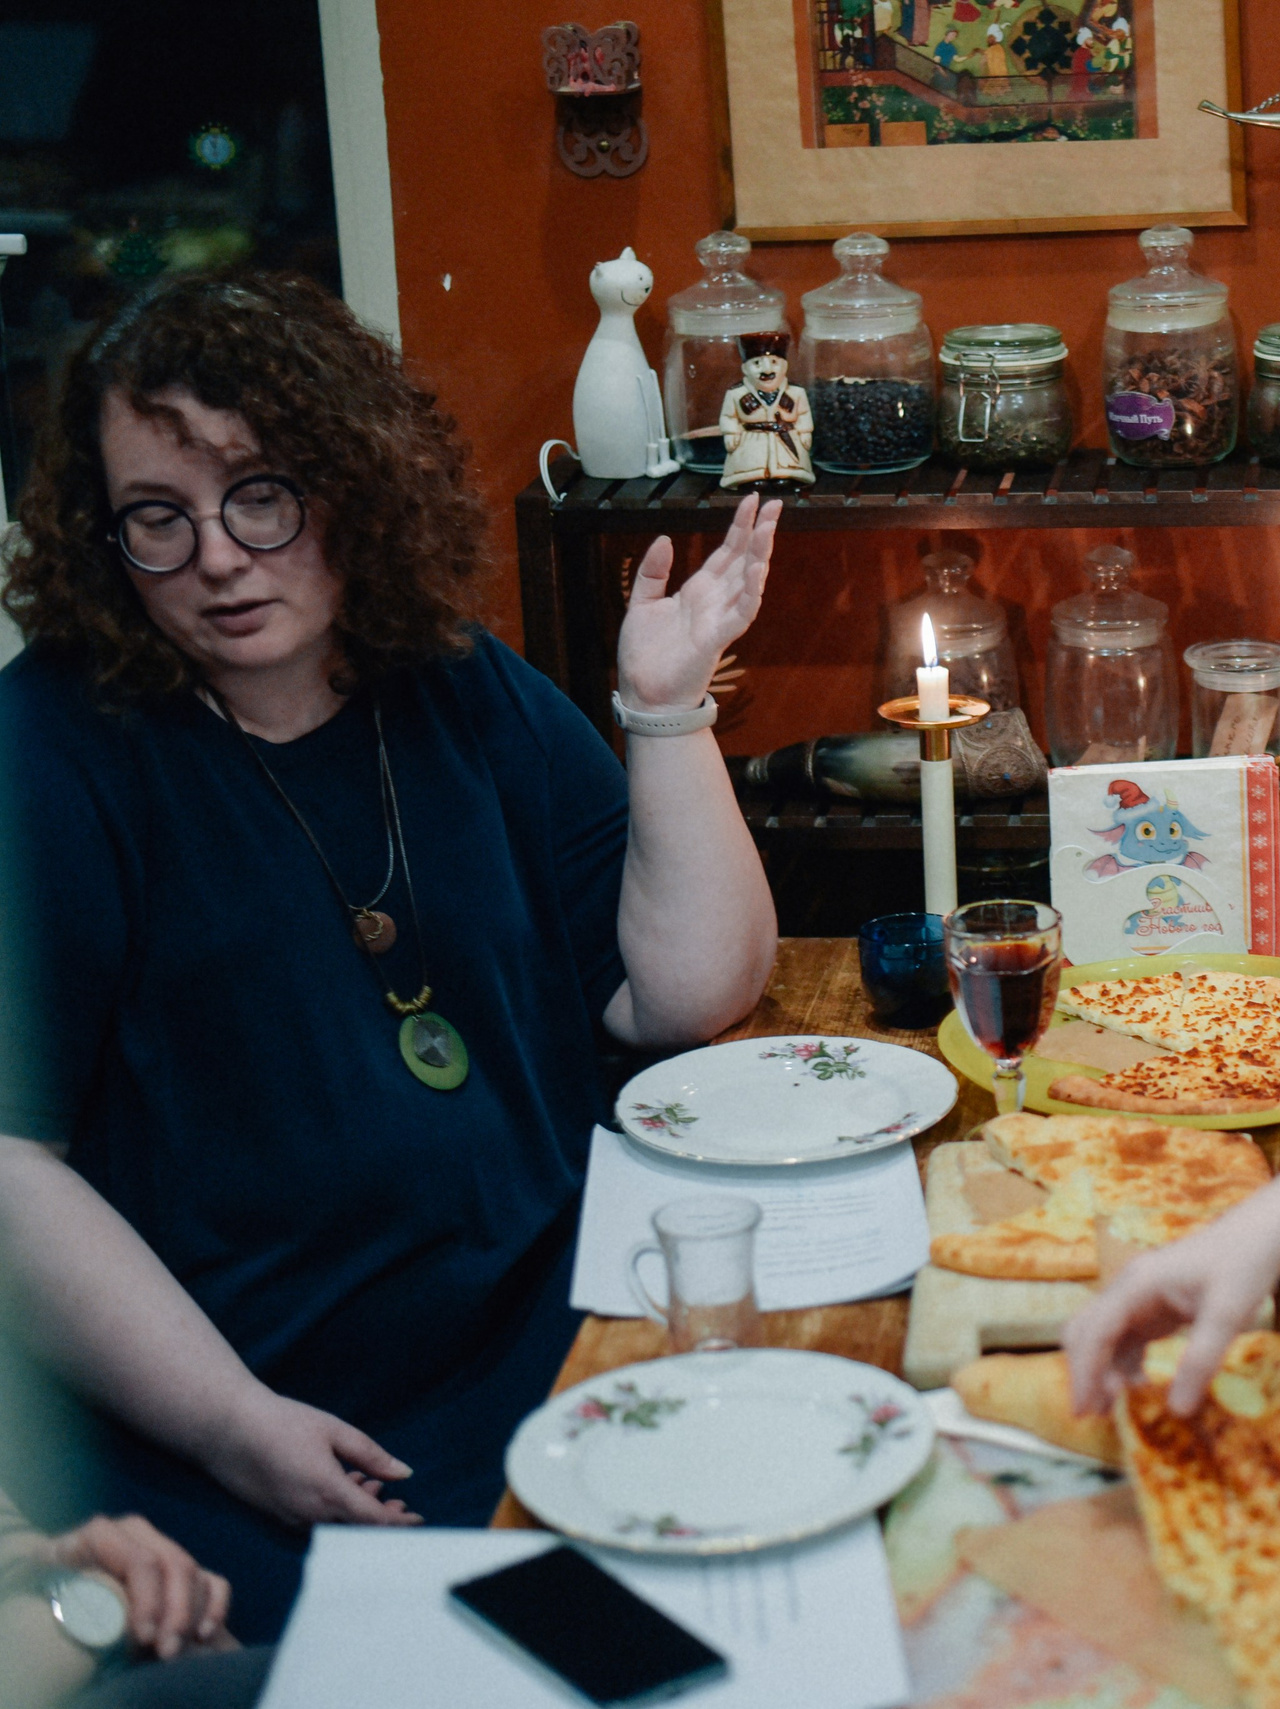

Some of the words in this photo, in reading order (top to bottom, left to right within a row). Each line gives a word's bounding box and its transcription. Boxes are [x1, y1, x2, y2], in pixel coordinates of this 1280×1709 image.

[1139, 413, 1164, 425] Путь
[1141, 897, 1214, 919] Счастлив
[1136, 917, 1198, 937] Нового
